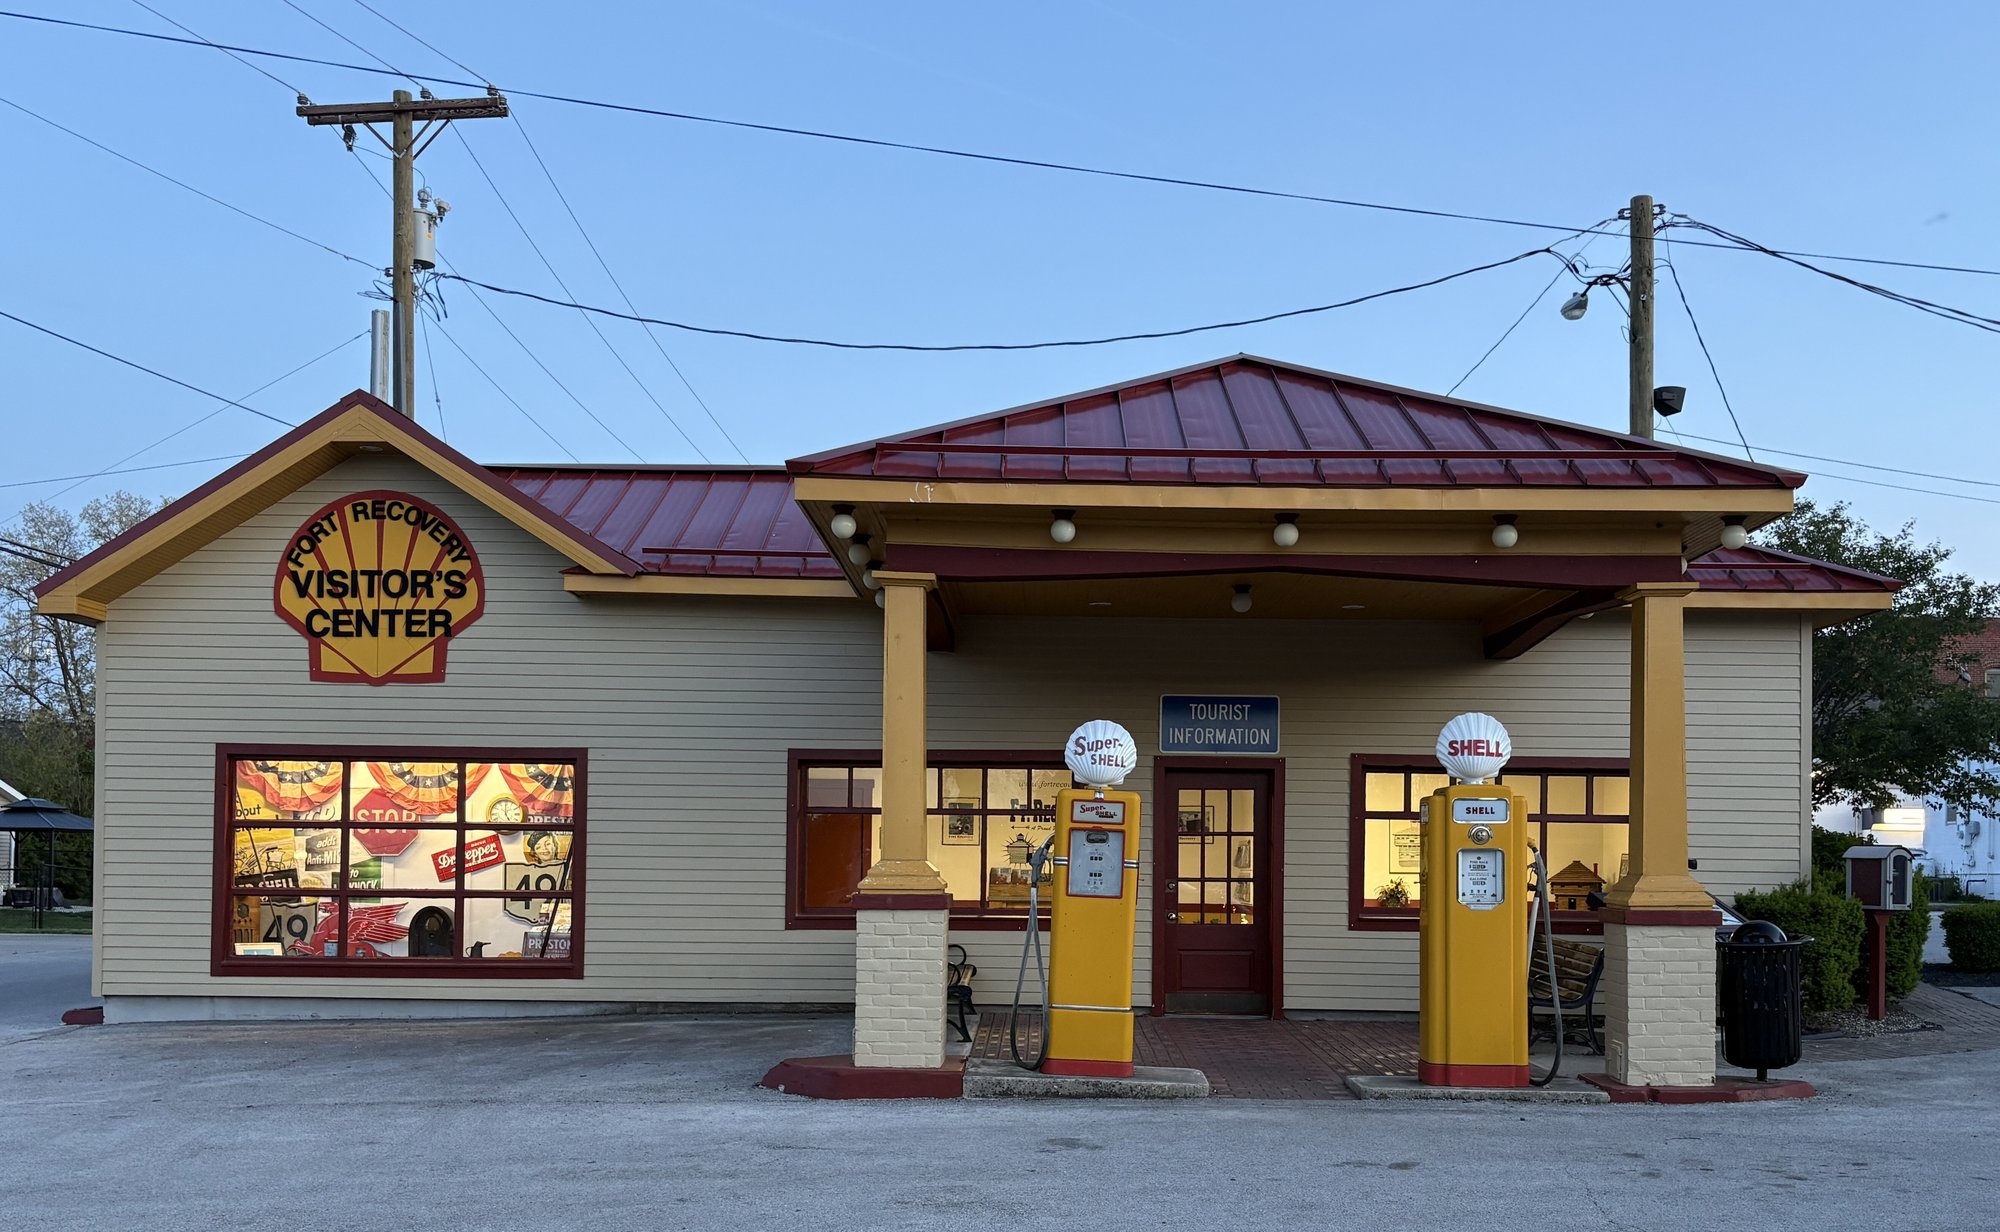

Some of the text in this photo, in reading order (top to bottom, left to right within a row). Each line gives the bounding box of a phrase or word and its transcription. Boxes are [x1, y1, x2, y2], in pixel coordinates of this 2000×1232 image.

[287, 500, 472, 568] FORT RECOVERY
[290, 569, 467, 599] VISITOR'S
[305, 608, 453, 638] CENTER
[1189, 703, 1251, 720] TOURIST
[1169, 727, 1270, 745] INFORMATION
[1448, 739, 1503, 758] SHELL
[1090, 754, 1127, 768] SHELL
[1465, 806, 1495, 815] SHELL
[356, 808, 416, 834] STOP
[316, 835, 337, 848] adds
[464, 843, 498, 863] epper
[511, 874, 557, 910] 49
[263, 914, 309, 943] 49
